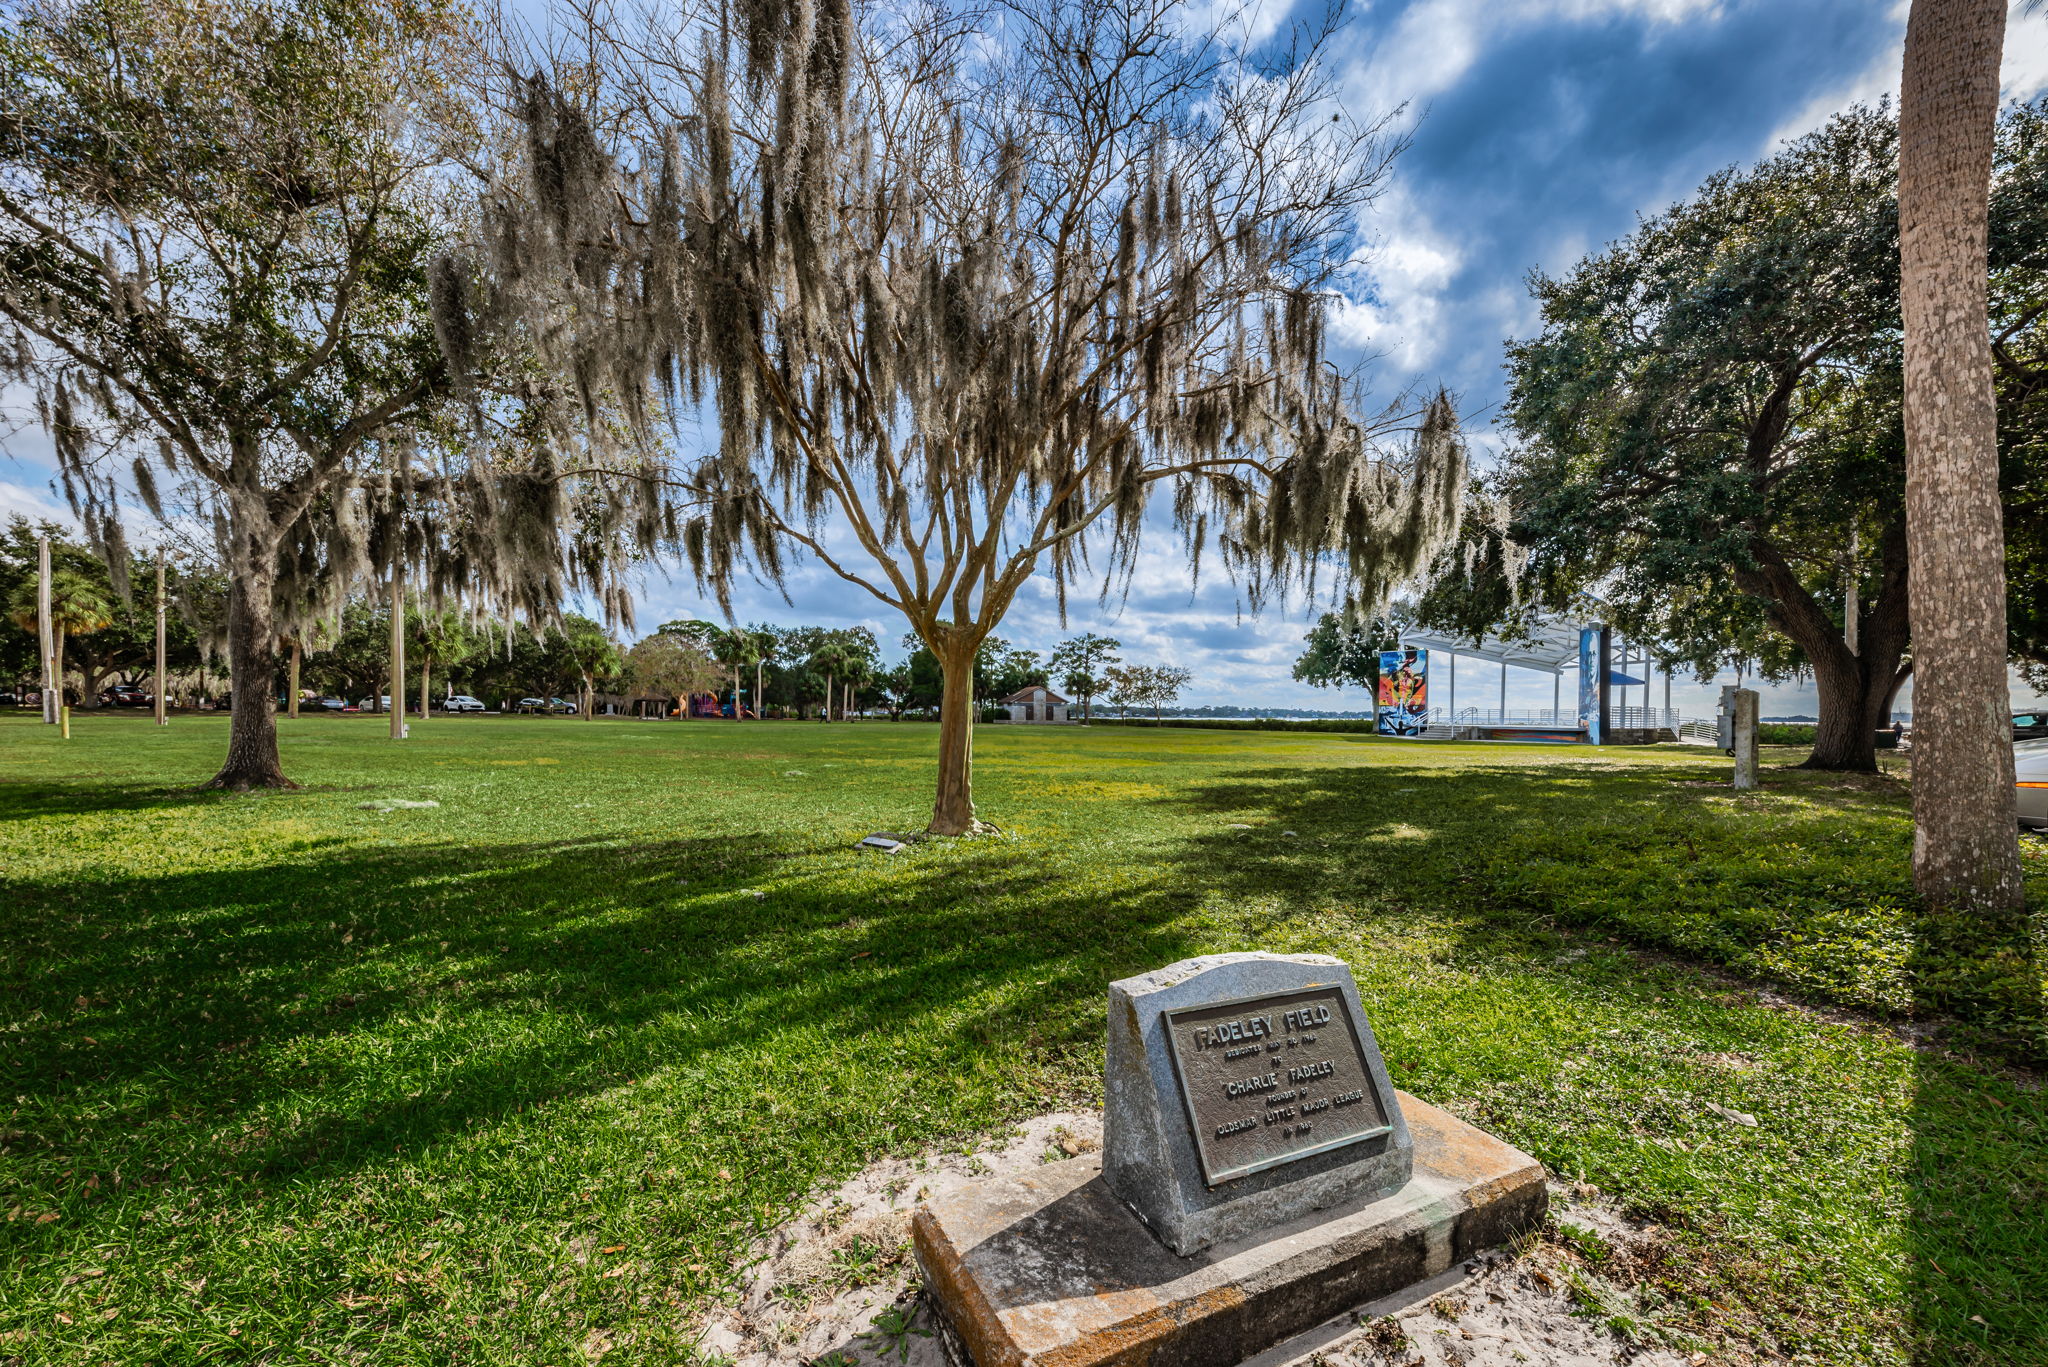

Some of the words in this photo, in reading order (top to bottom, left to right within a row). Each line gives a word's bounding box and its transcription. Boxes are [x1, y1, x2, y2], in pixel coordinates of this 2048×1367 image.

[1196, 1014, 1273, 1049] FADELEY
[1285, 1005, 1331, 1029] FIELD
[1272, 1055, 1283, 1064] TO
[1289, 1059, 1335, 1081] FADELEY
[1267, 1089, 1297, 1103] FOUNDER
[1300, 1086, 1309, 1095] OF
[1217, 1116, 1257, 1135] OLDSMAR
[1265, 1106, 1296, 1122] LITTLE
[1303, 1097, 1330, 1113] MAJOR
[1334, 1089, 1364, 1104] LEAGUE
